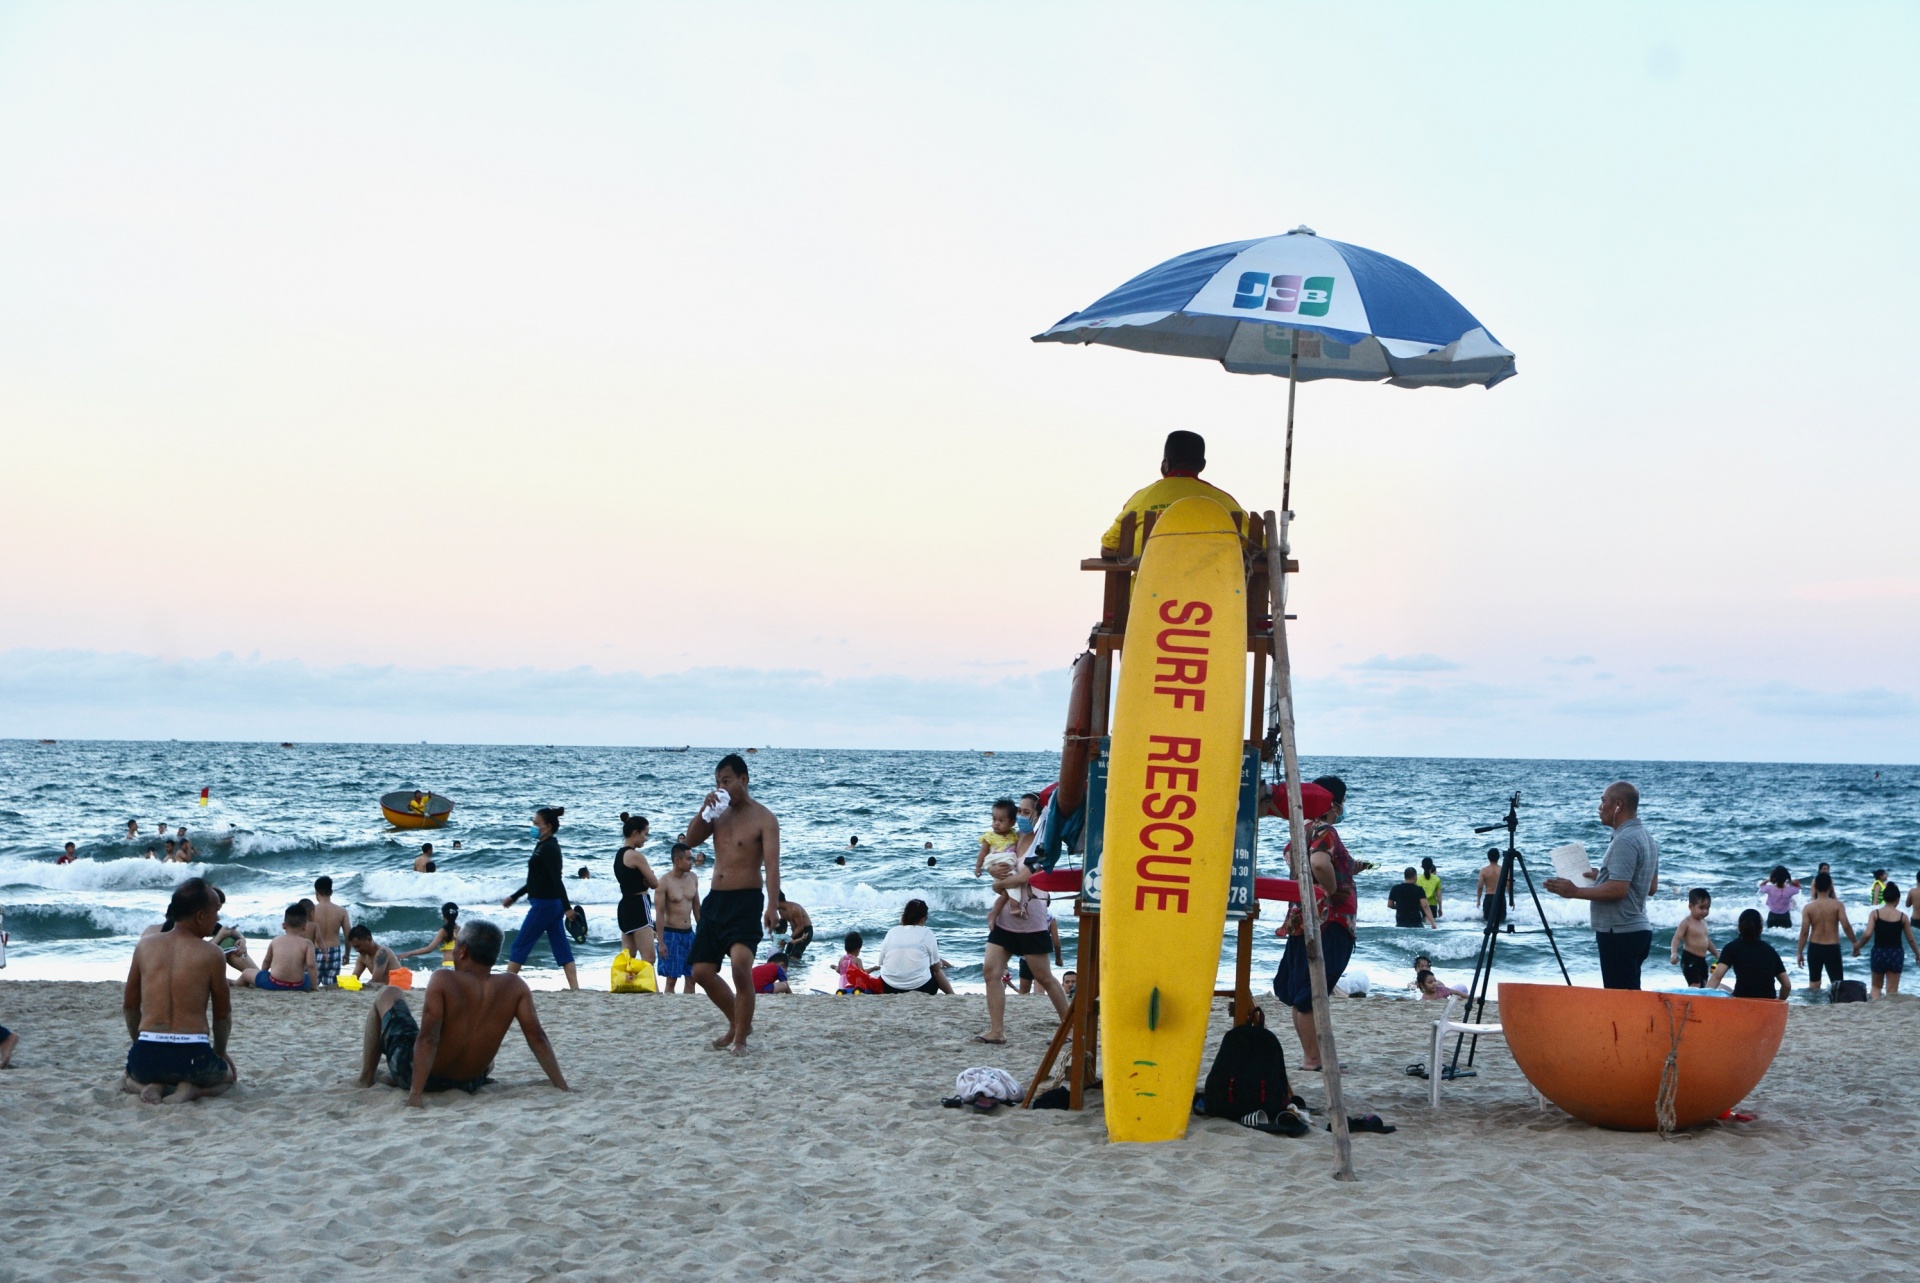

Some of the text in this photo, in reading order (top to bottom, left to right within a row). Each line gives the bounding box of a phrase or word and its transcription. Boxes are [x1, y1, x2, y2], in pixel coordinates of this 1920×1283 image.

[1233, 271, 1335, 317] JCB
[1135, 599, 1213, 914] SURF RESCUE
[1235, 848, 1250, 860] 19h
[1238, 866, 1249, 877] 30
[1227, 886, 1248, 905] 78
